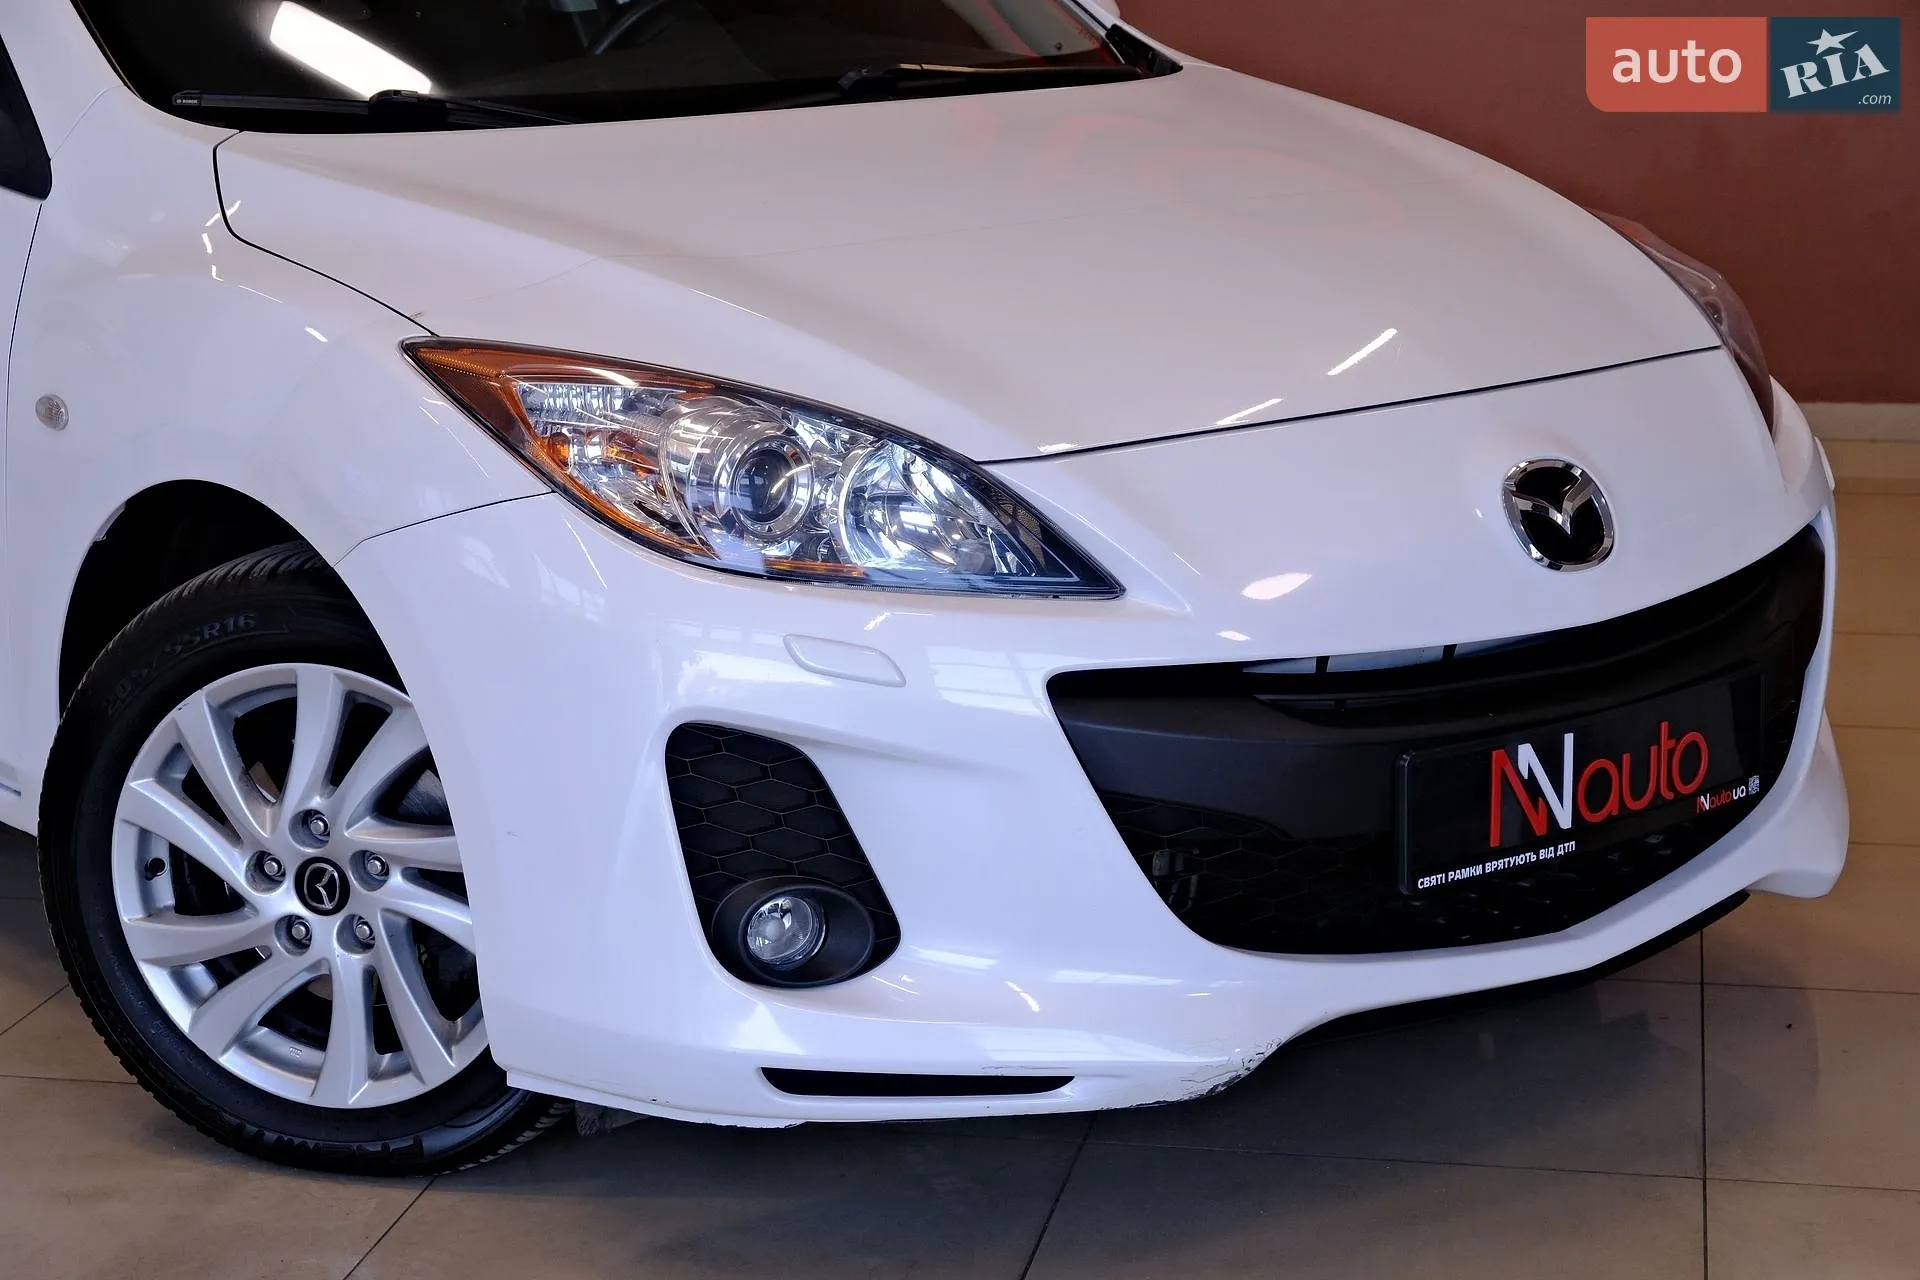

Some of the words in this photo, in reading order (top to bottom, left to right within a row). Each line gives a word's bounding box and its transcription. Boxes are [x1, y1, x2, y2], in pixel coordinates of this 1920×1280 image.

[1417, 873, 1446, 889] СВЯТІ
[1448, 864, 1483, 882] РАМКИ
[1485, 853, 1537, 874] ВРЯТУЮТЬ
[1539, 847, 1555, 860] ВІД
[1557, 840, 1576, 856] ДТП
